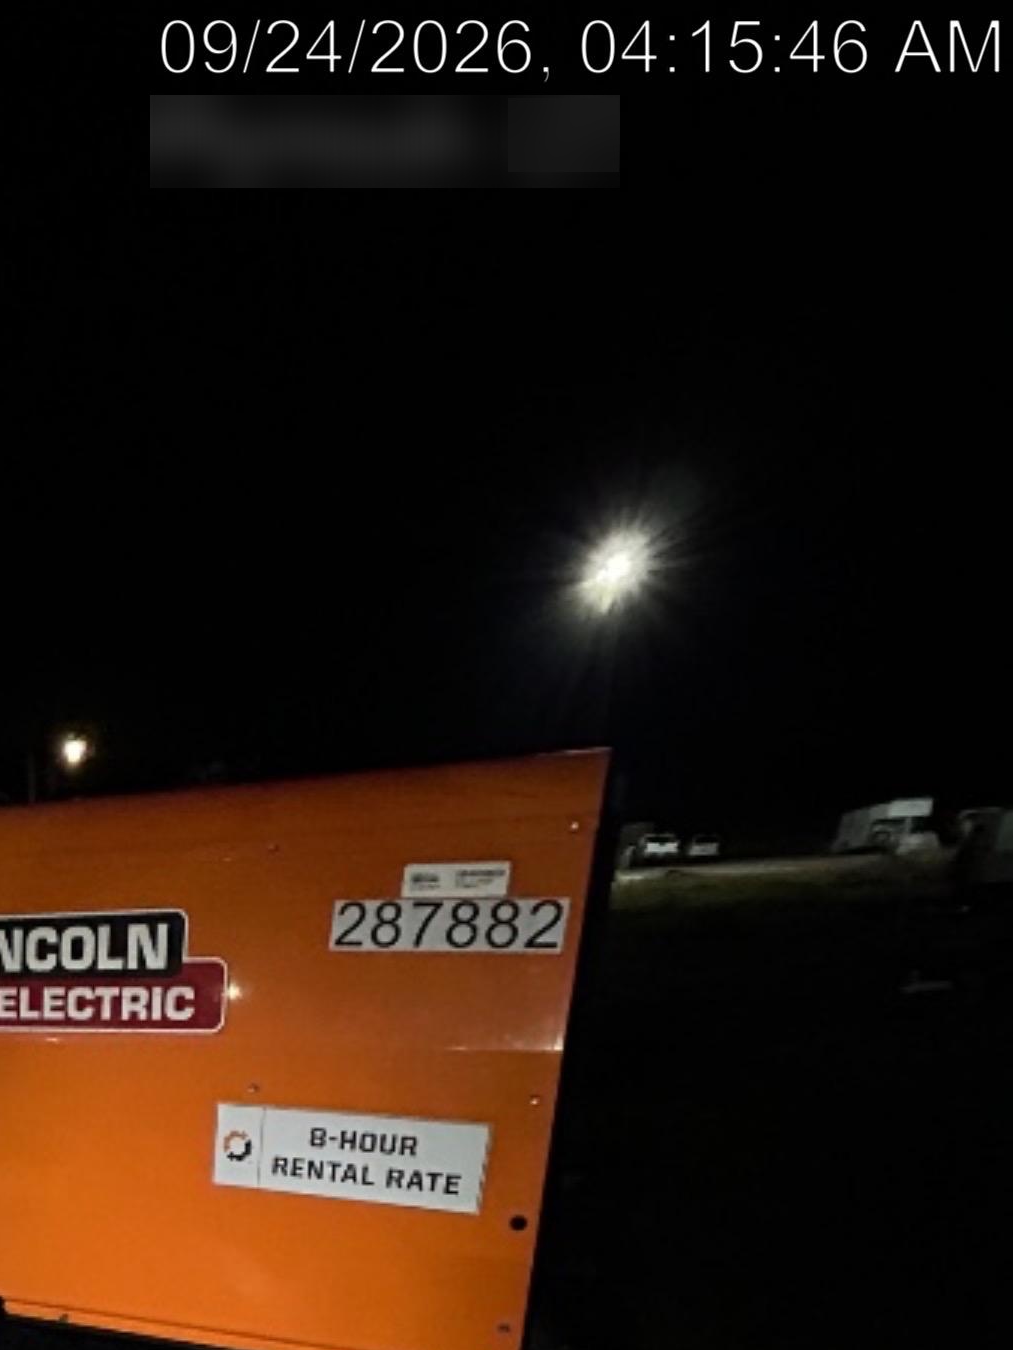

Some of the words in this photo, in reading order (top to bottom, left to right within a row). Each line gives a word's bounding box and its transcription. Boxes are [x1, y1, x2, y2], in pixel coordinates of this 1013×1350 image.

[334, 899, 564, 949] 287882
[309, 1126, 419, 1157] 8-HOUR
[271, 1156, 375, 1187] RENTAL
[385, 1168, 463, 1196] RATE
